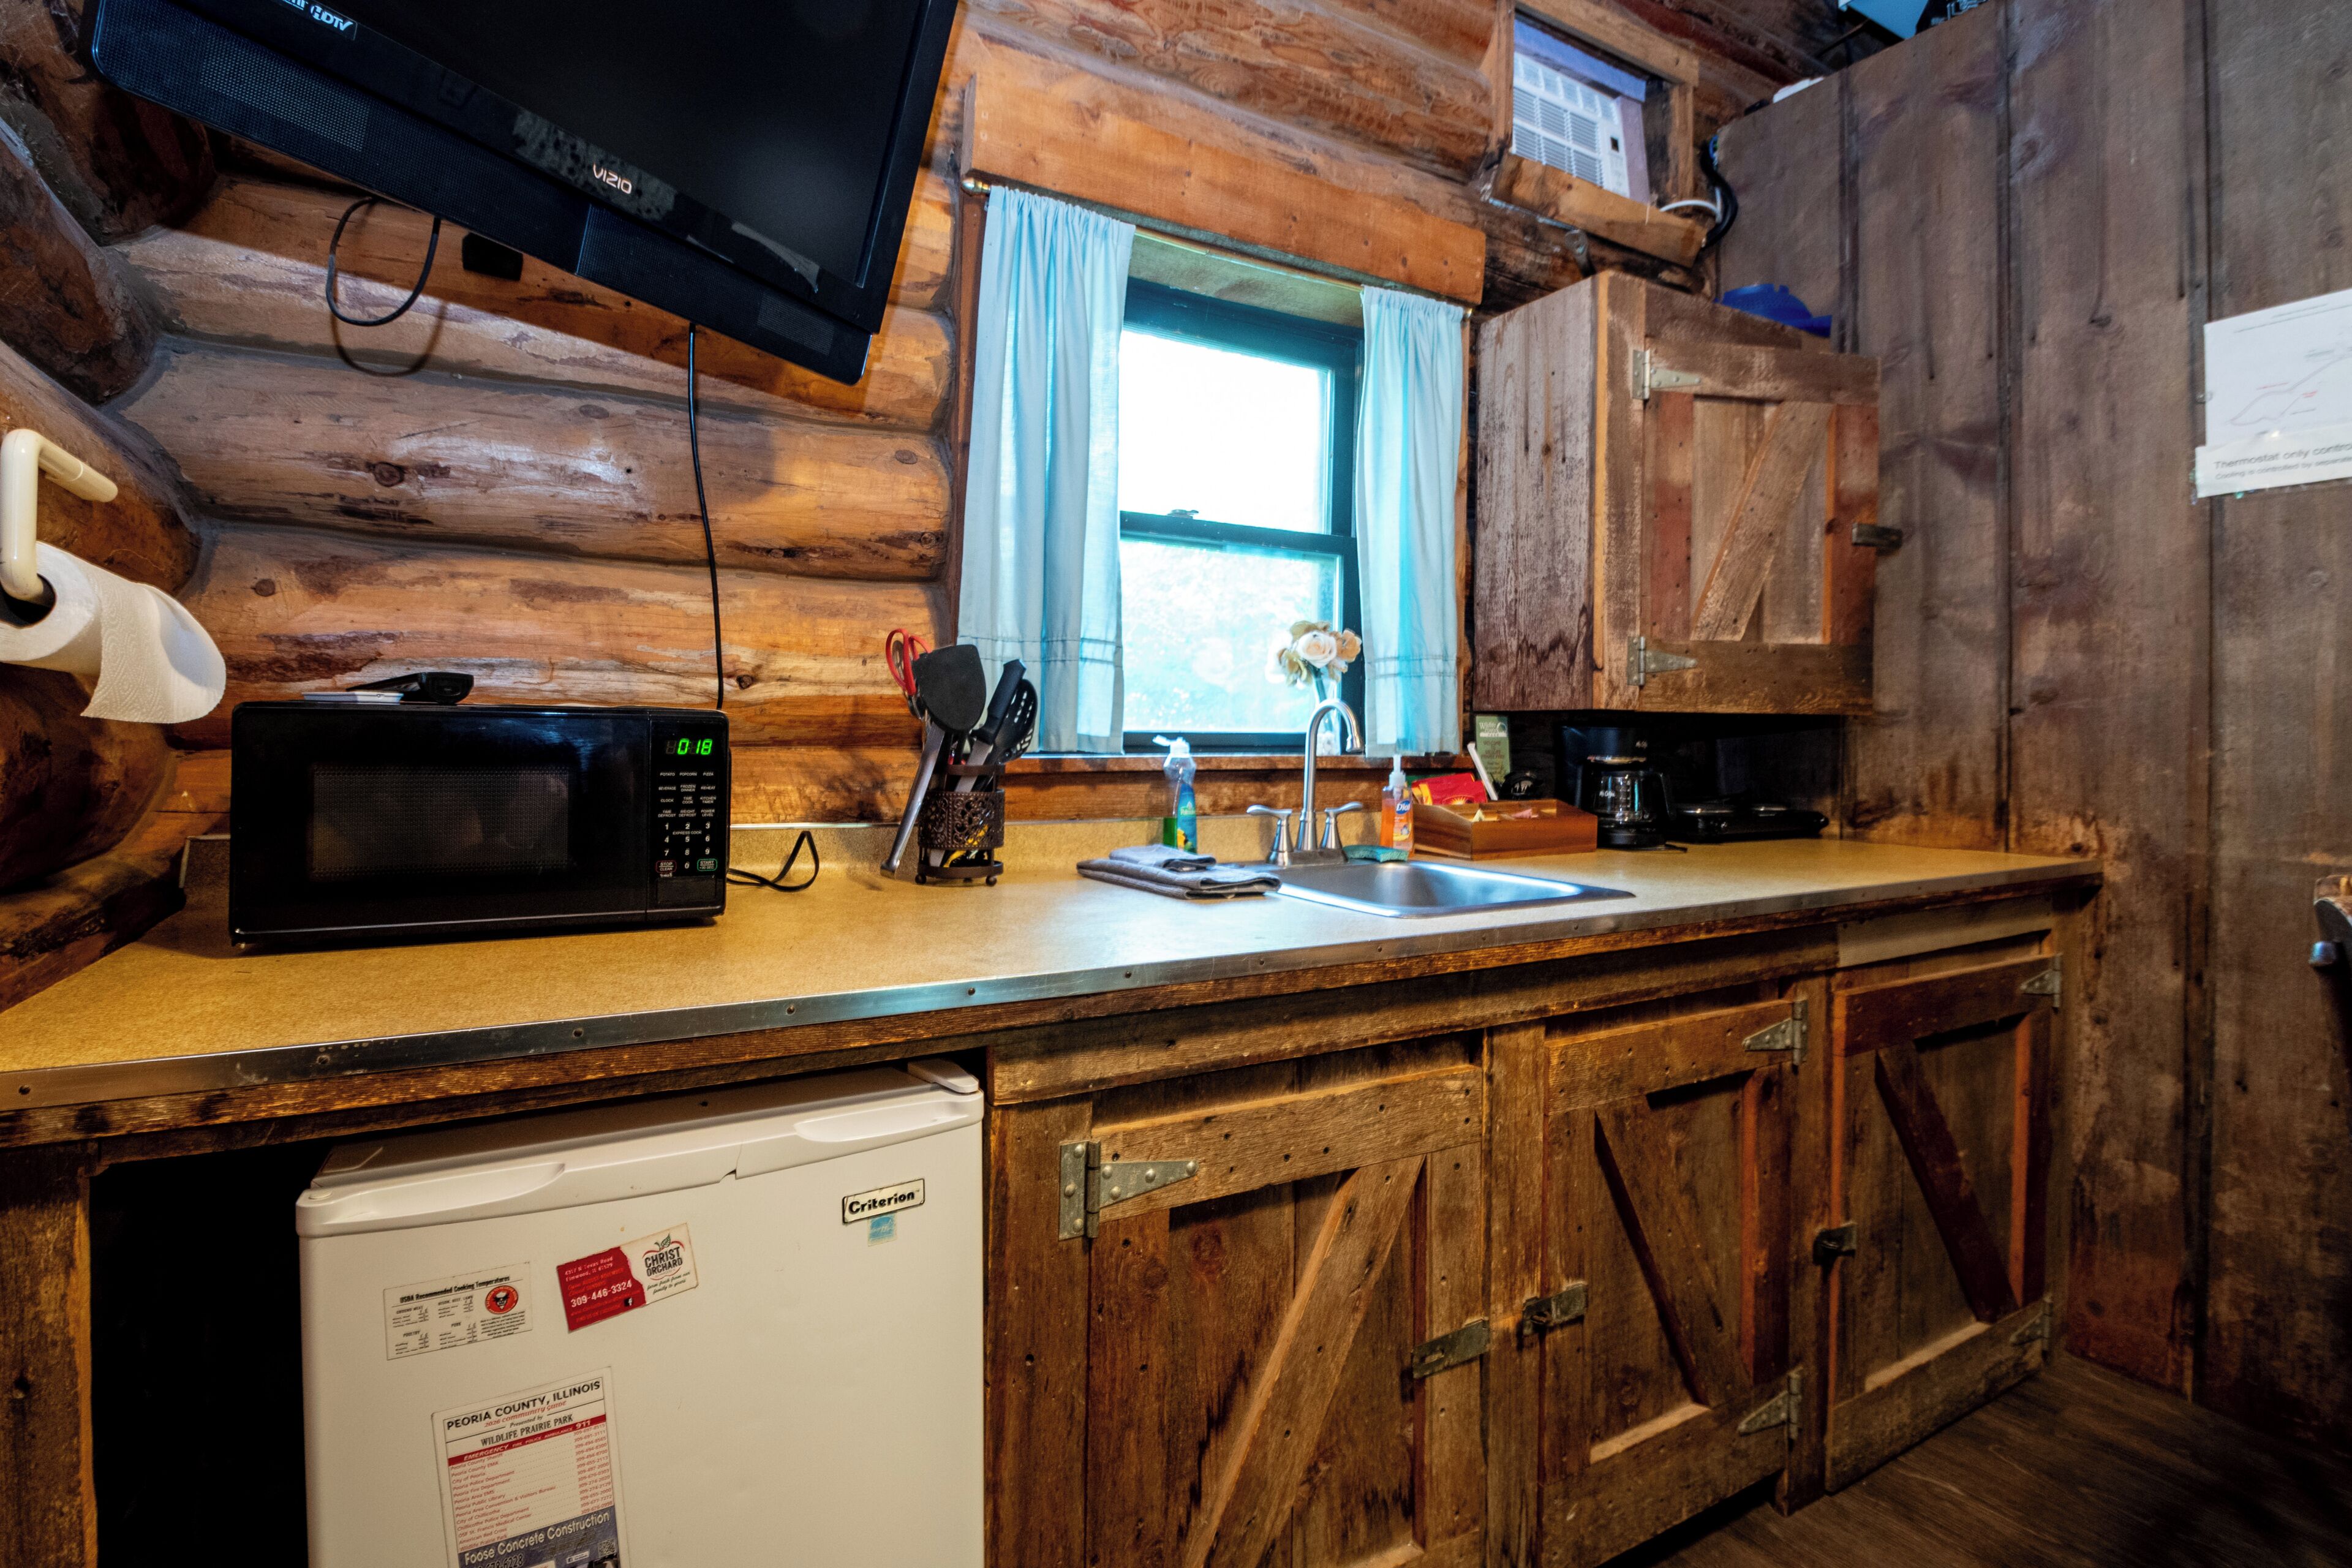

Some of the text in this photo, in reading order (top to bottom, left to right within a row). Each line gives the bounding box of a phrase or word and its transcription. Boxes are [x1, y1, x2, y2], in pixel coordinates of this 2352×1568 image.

[311, 5, 353, 31] HDTV
[593, 162, 632, 194] VIZIO
[2214, 453, 2279, 470] Thermostat
[2283, 449, 2310, 459] only
[1396, 803, 1411, 812] Dial
[848, 1191, 915, 1215] Criterion
[600, 1256, 612, 1264] Road
[644, 1246, 681, 1268] CHRIST
[646, 1256, 683, 1276] ORCHARD
[415, 1287, 452, 1300] Recommended
[454, 1283, 475, 1292] Cooking
[475, 1276, 510, 1289] Temperatures
[570, 1278, 633, 1308] 309-446-3324
[652, 1285, 668, 1295] family
[446, 1380, 600, 1430] PEORIA COUNTY, ILLINOIS
[480, 1414, 573, 1447] WILDLIFE PRAIRIE PARK
[483, 1419, 500, 1427] 2026
[509, 1417, 535, 1428] Presented
[464, 1444, 508, 1461] EMERGENCY
[544, 1427, 572, 1438] AMBULANCE
[576, 1420, 590, 1429] 911
[467, 1457, 485, 1466] County
[468, 1464, 486, 1473] County
[480, 1478, 510, 1490] Department
[485, 1470, 514, 1482] Department
[484, 1498, 513, 1509] Convention
[519, 1490, 537, 1499] Visitors
[538, 1485, 556, 1493] Bureau
[488, 1493, 505, 1502] Library
[456, 1520, 483, 1531] Chillicothe
[499, 1506, 529, 1519] Department
[473, 1508, 500, 1520] Chillicothe
[495, 1517, 514, 1526] Medical
[459, 1534, 482, 1545] American
[464, 1548, 495, 1566] Foose
[497, 1534, 545, 1555] Concrete
[547, 1512, 611, 1540] Construction
